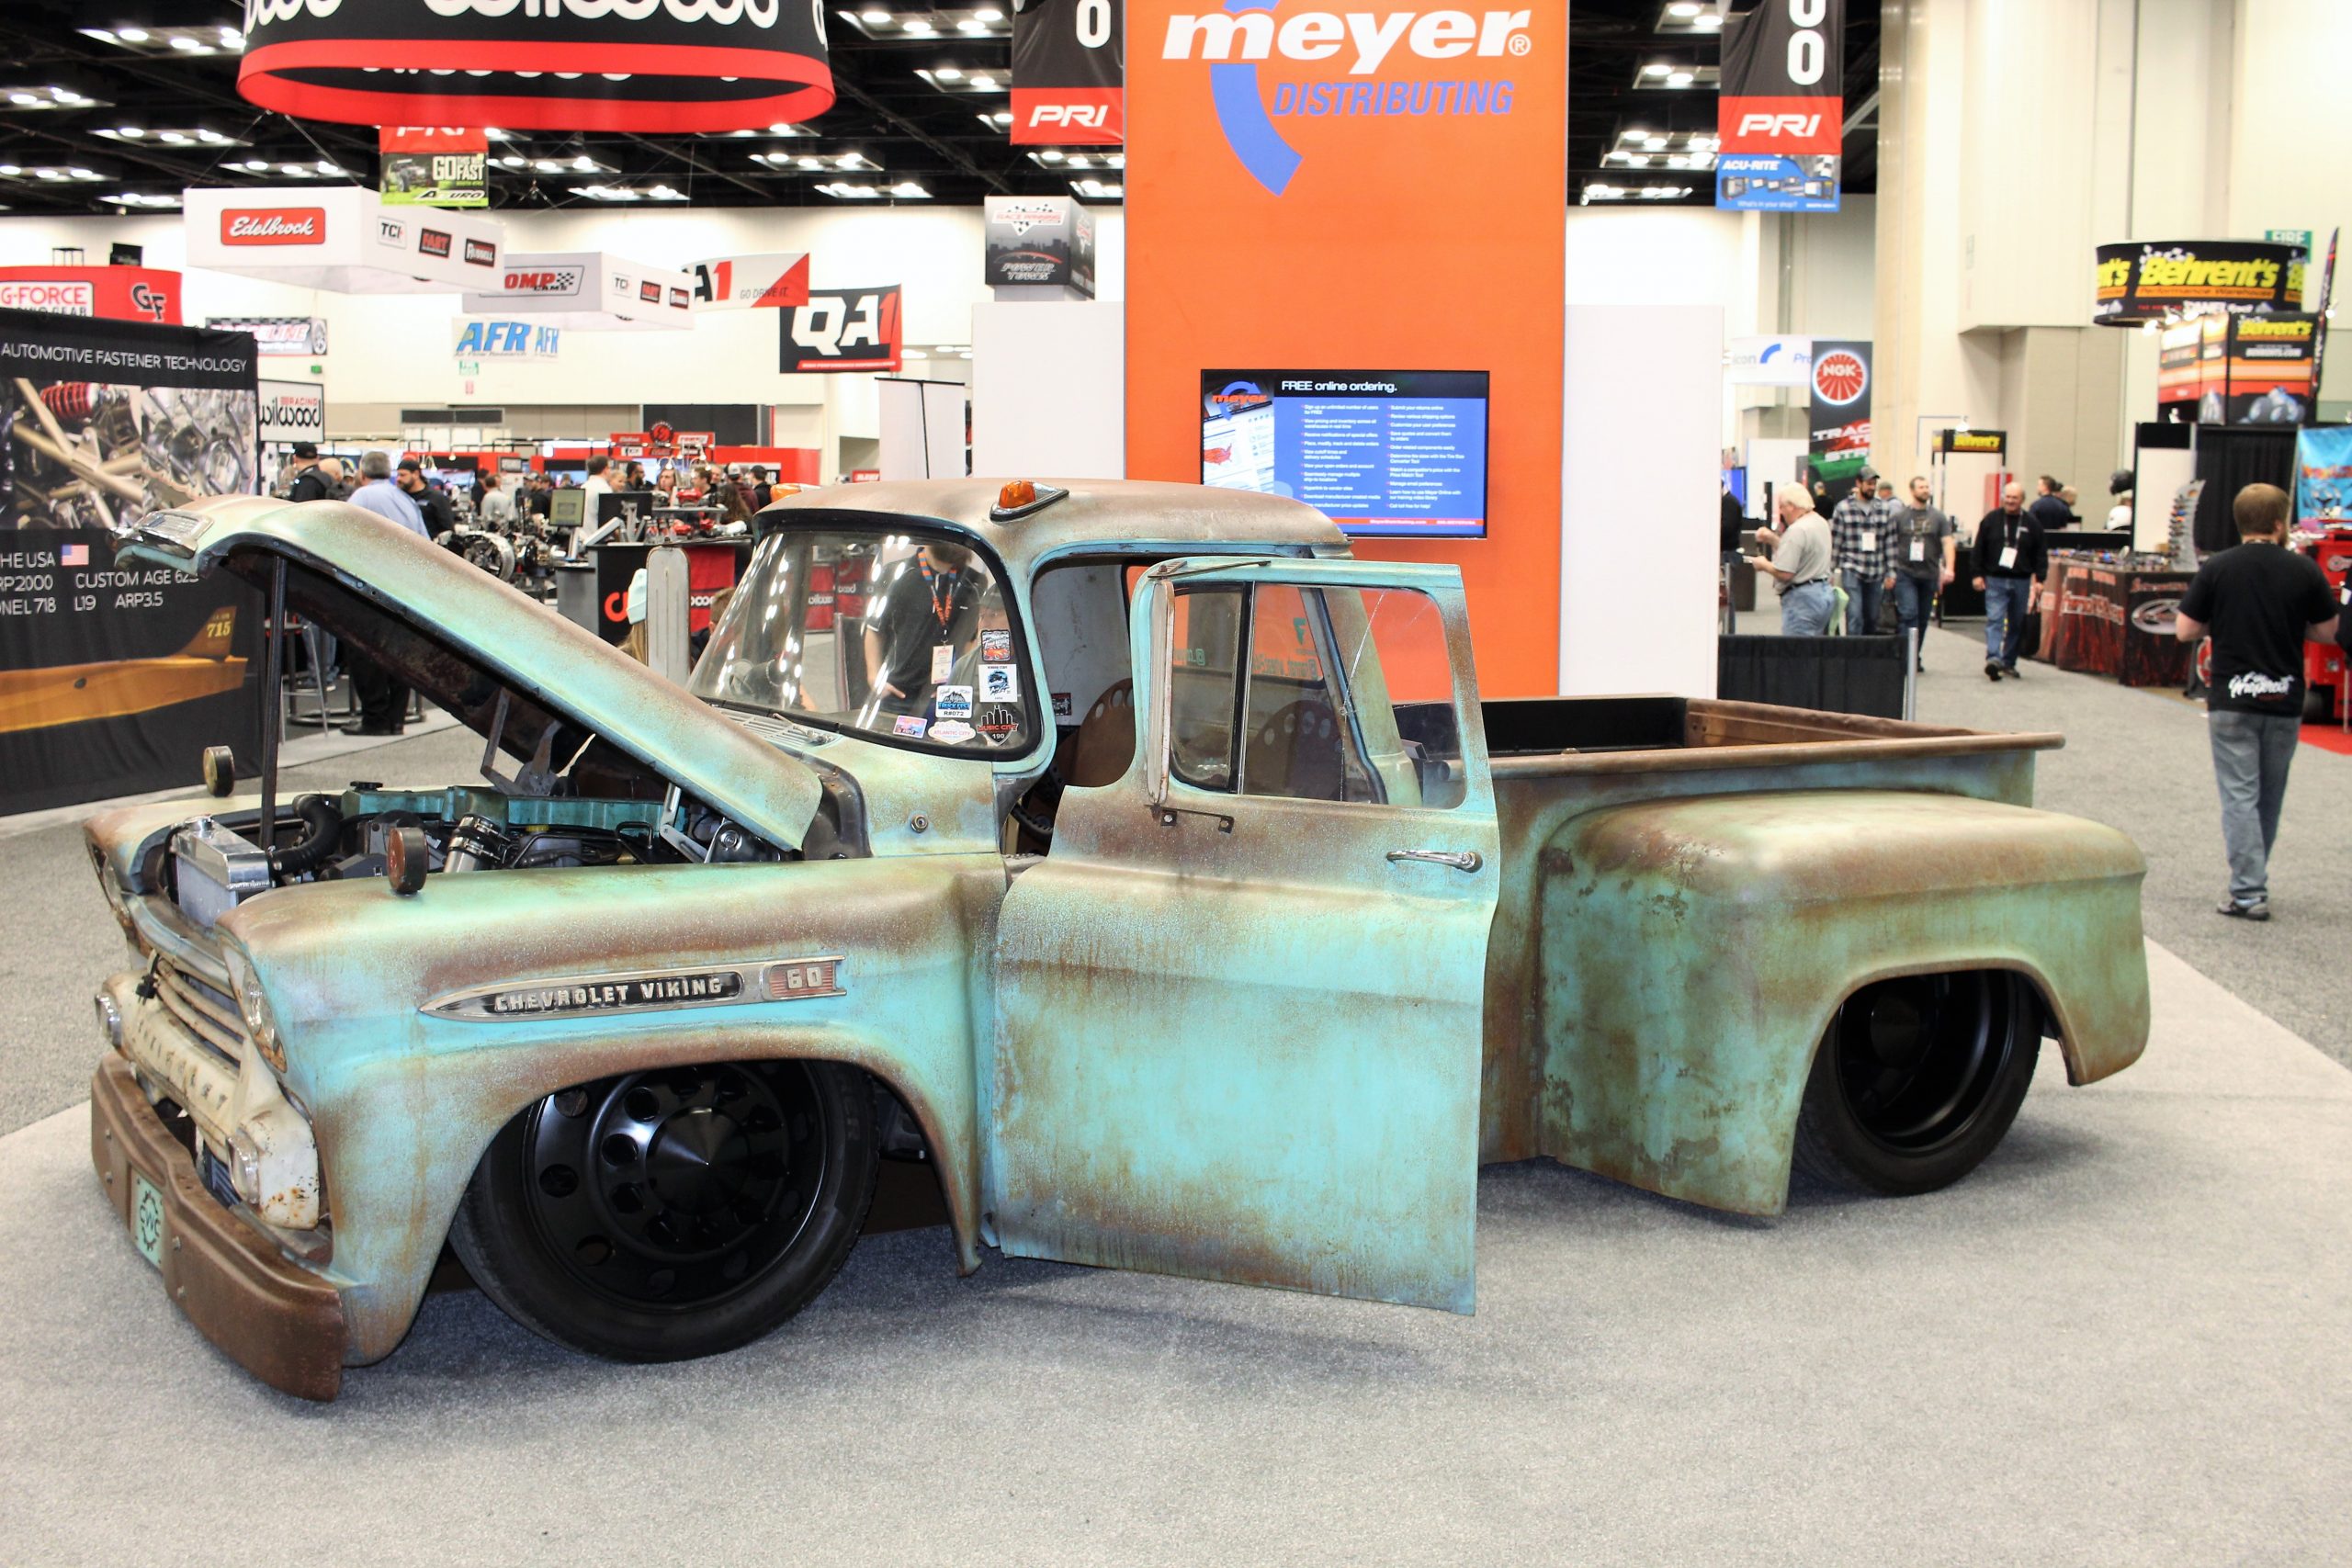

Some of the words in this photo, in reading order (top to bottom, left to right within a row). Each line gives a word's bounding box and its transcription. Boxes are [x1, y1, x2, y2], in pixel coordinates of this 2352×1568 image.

[1272, 81, 1514, 116] DISTRIBUTING
[1029, 105, 1108, 128] PRI
[1737, 113, 1822, 137] PRI
[433, 156, 457, 181] GO
[457, 164, 485, 181] FAST
[1722, 161, 1781, 171] ACU-RITE
[229, 216, 315, 237] Edelbrock
[504, 273, 556, 289] OMP
[2140, 254, 2280, 288] Behrent's
[740, 289, 752, 300] GO
[752, 287, 778, 299] DRIVE
[791, 291, 898, 355] QA1
[456, 321, 531, 352] AFR
[2, 343, 93, 364] AUTOMOTIVE
[96, 350, 162, 368] FASTENER
[164, 355, 247, 373] TECHNOLOGY
[1822, 365, 1856, 377] NGK
[1282, 380, 1314, 391] FREE
[1315, 380, 1348, 391] online
[1349, 381, 1397, 394] ordering.
[26, 551, 56, 569] USA
[75, 570, 140, 589] CUSTOM
[143, 569, 172, 586] AGE
[33, 597, 57, 614] 718
[74, 594, 96, 612] L19
[115, 592, 164, 609] ARP3.5
[207, 621, 232, 638] 715
[494, 985, 629, 1012] CHEVROLET
[640, 977, 724, 999] VIKING
[786, 966, 824, 989] 60
